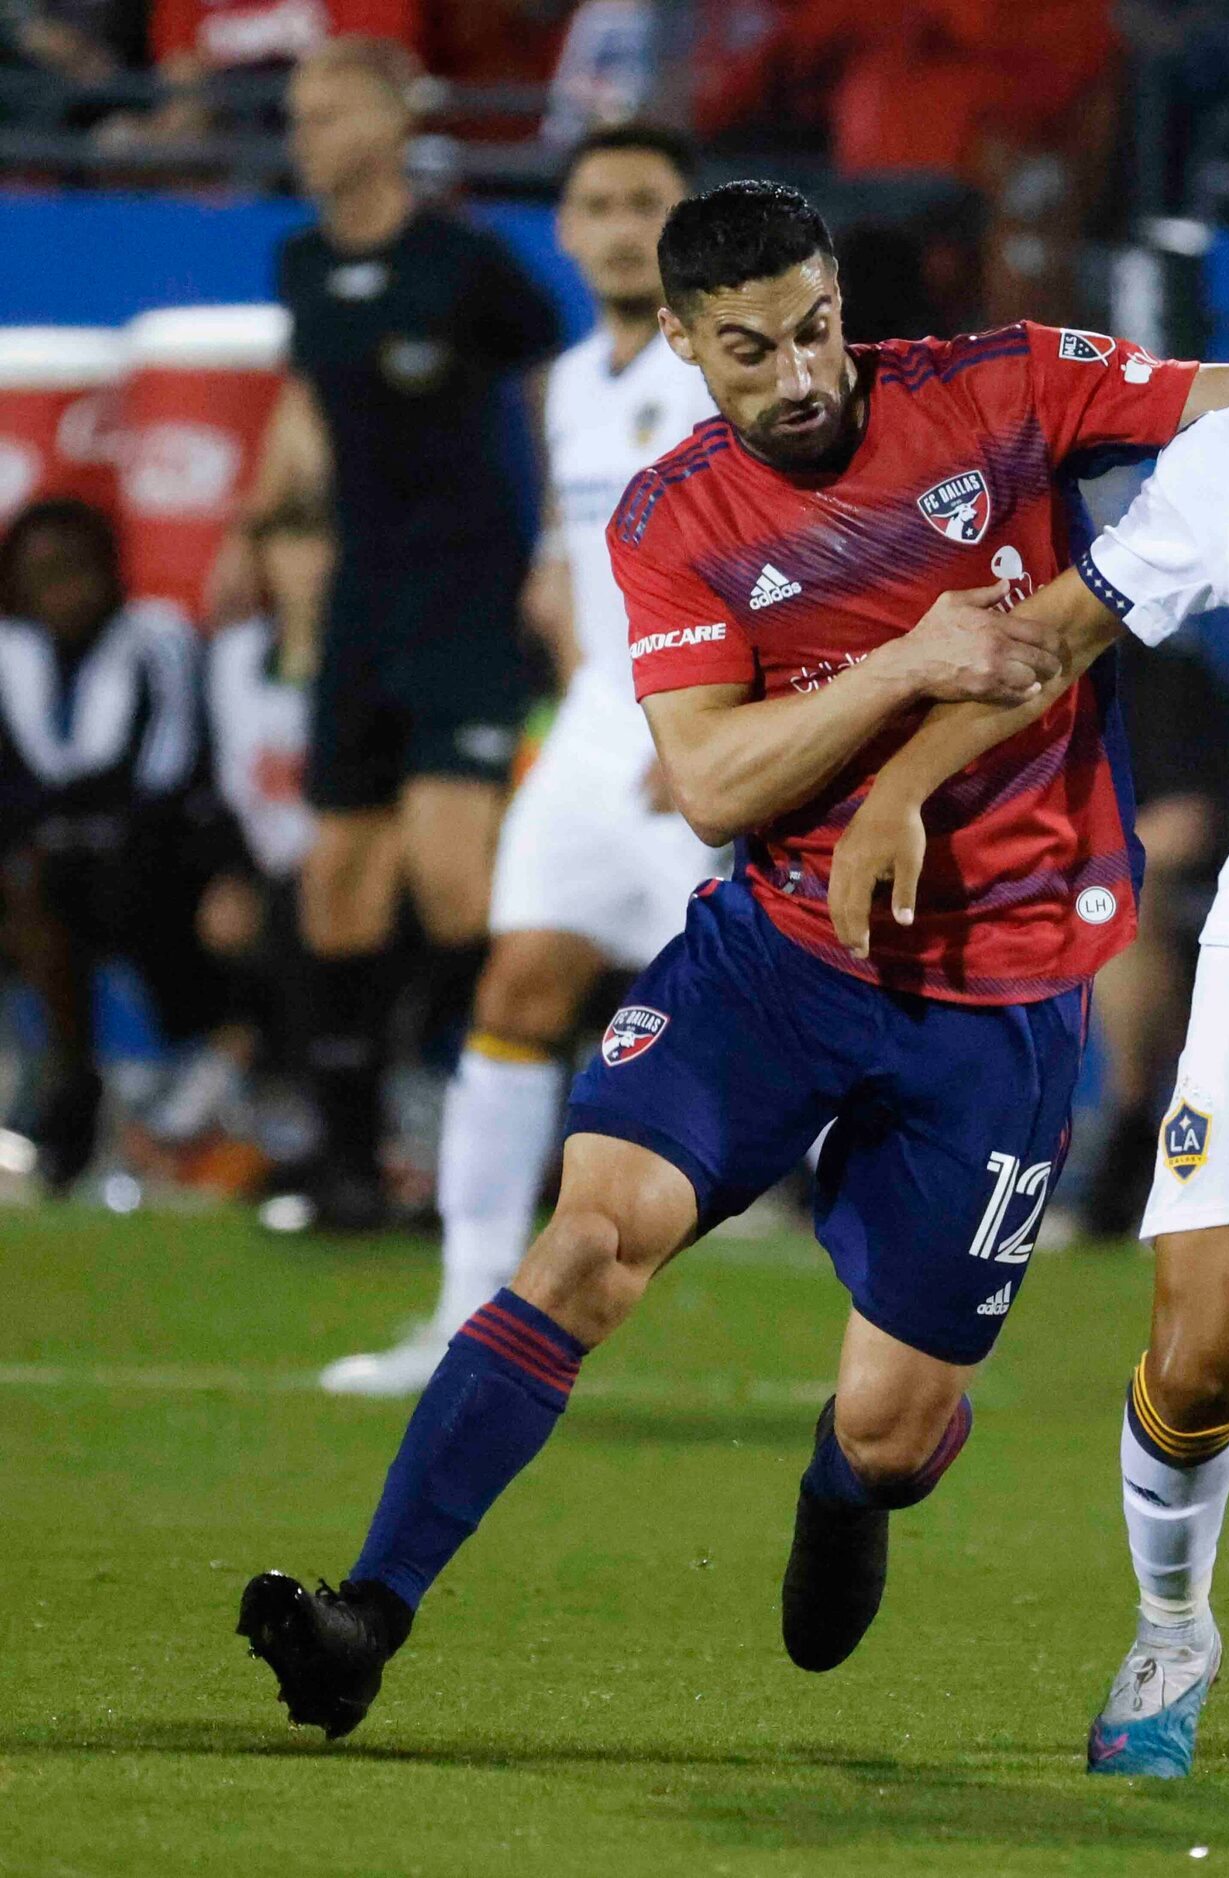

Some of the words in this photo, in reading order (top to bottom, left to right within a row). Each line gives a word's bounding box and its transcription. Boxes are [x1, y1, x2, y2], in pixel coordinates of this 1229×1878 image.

[1063, 336, 1077, 356] MLS
[923, 494, 940, 514] FC
[938, 475, 980, 504] DALLAS
[750, 581, 802, 610] adidas
[1085, 898, 1107, 913] LH
[626, 1011, 661, 1033] DALLAS
[1170, 1128, 1200, 1152] LA
[969, 1151, 1052, 1264] 12
